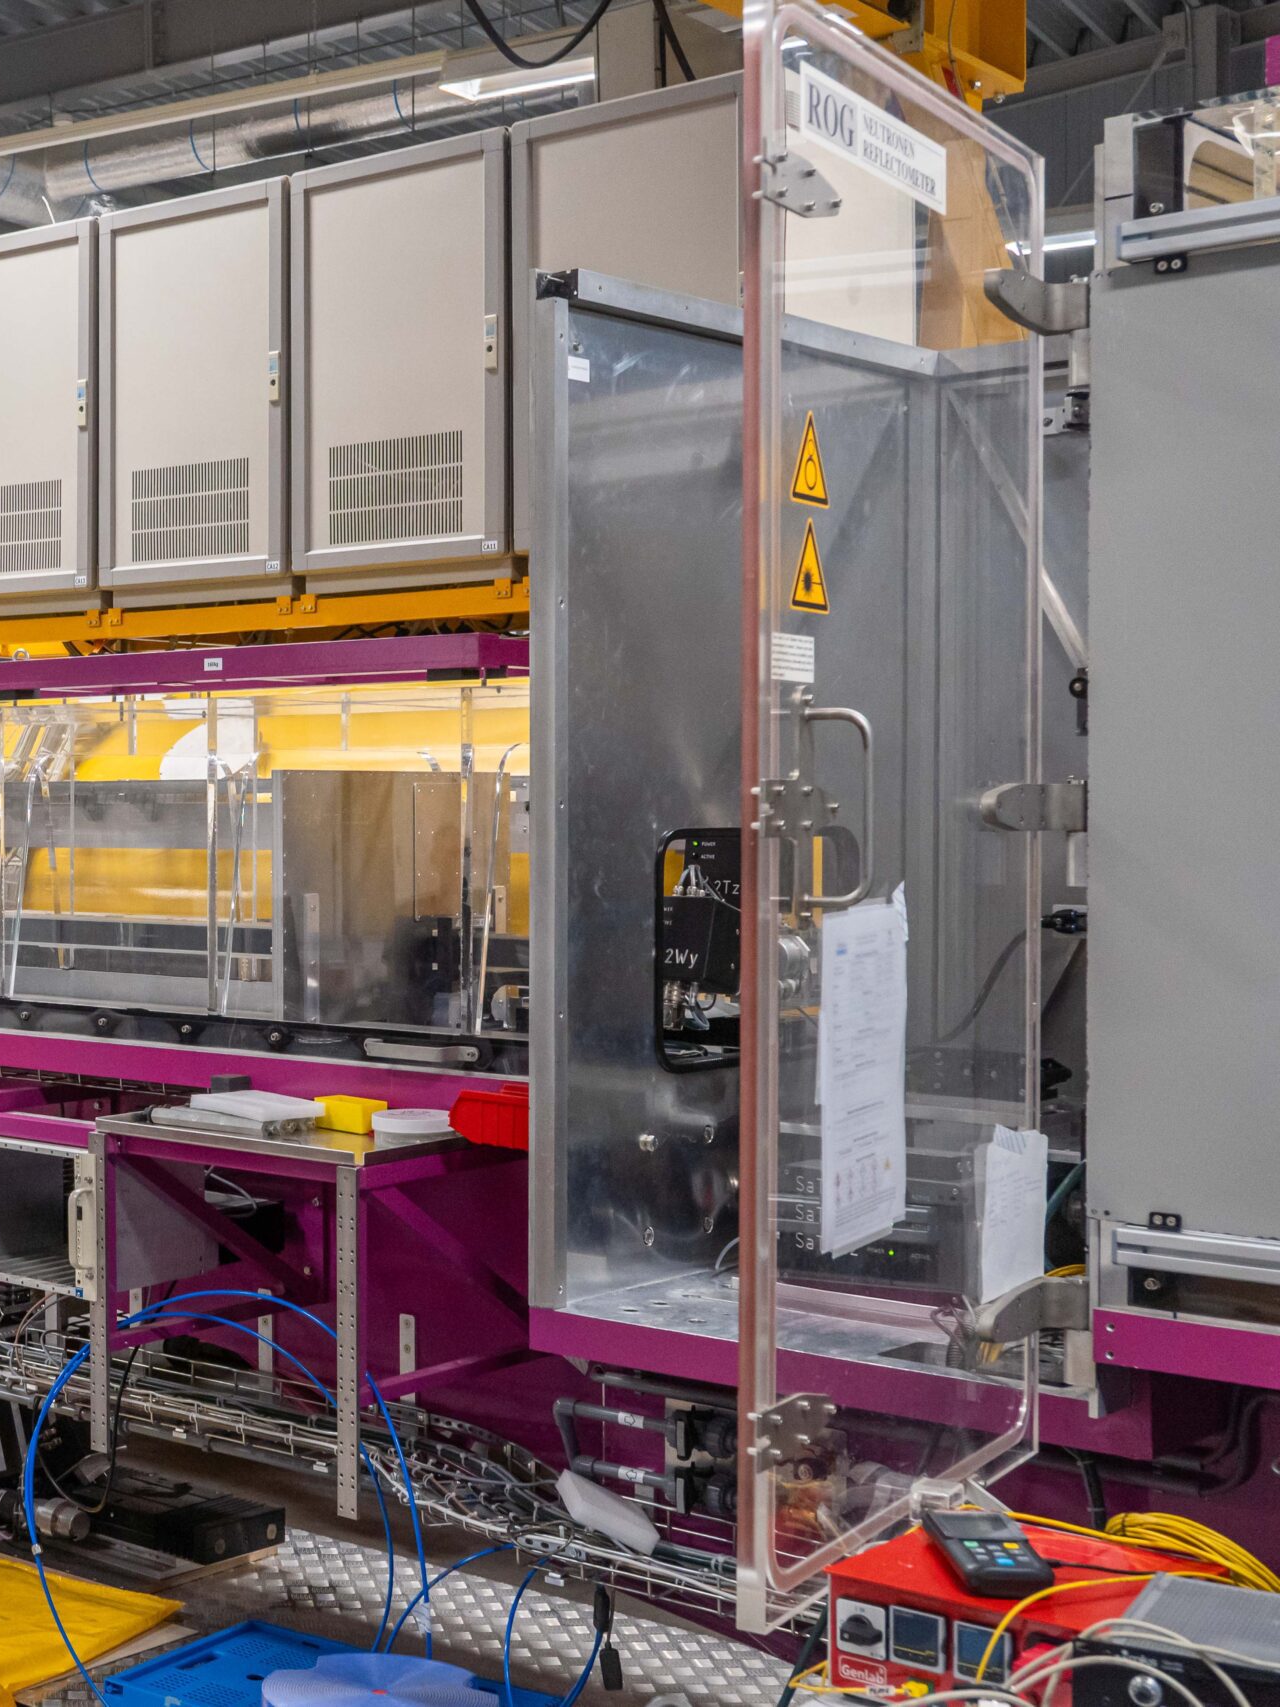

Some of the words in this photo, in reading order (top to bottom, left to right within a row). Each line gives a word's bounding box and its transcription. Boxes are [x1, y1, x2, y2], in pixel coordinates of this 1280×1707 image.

[807, 82, 854, 147] ROG
[863, 138, 937, 198] REFLECTOMETER
[840, 1664, 885, 1685] Genlab
